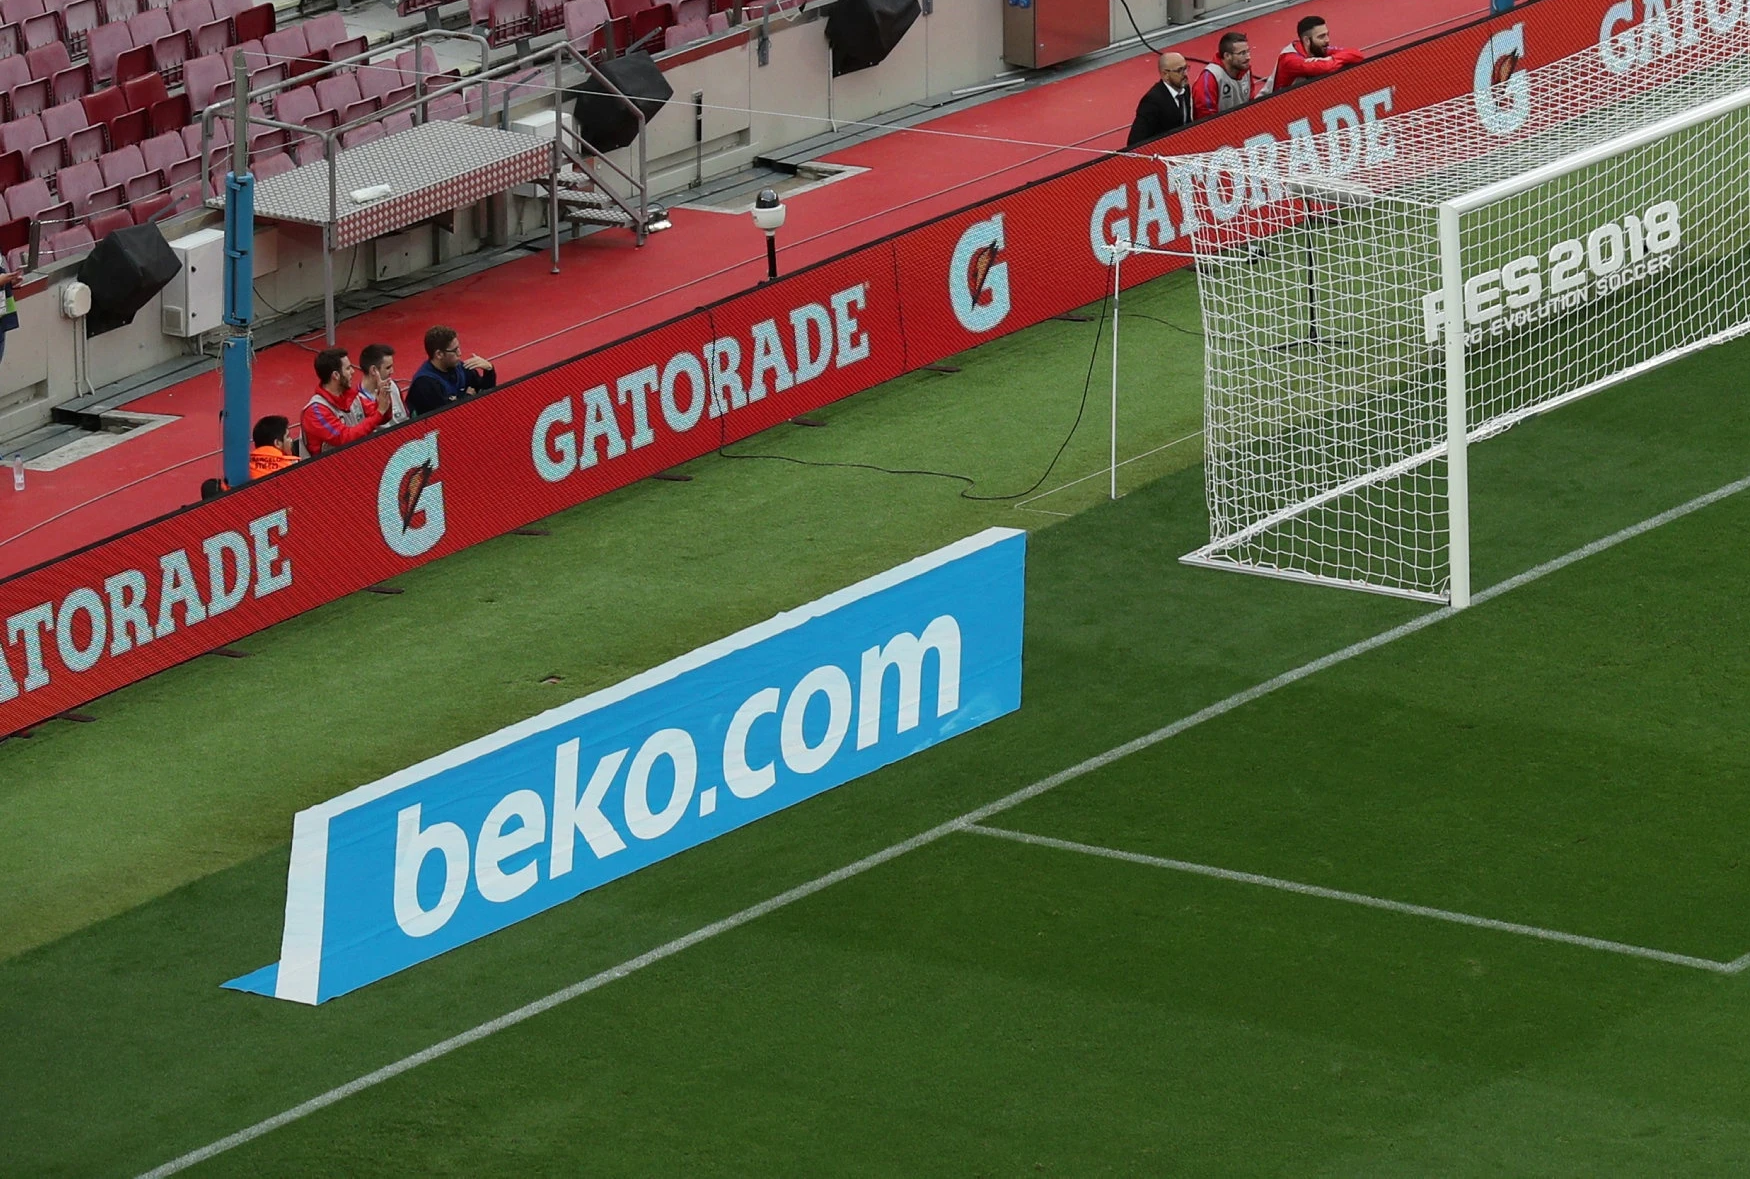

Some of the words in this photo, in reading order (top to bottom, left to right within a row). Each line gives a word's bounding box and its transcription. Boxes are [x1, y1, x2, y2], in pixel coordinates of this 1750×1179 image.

[1474, 23, 1531, 135] G
[1090, 86, 1396, 266] GATORADE
[948, 212, 1011, 333] G
[1464, 326, 1483, 348] RO
[1490, 286, 1588, 337] EVOLUTION
[1596, 255, 1672, 296] SOCCER
[1549, 200, 1681, 295] 2018
[531, 282, 871, 483] GATORADE
[377, 431, 447, 557] G
[393, 614, 961, 938] beko.com
